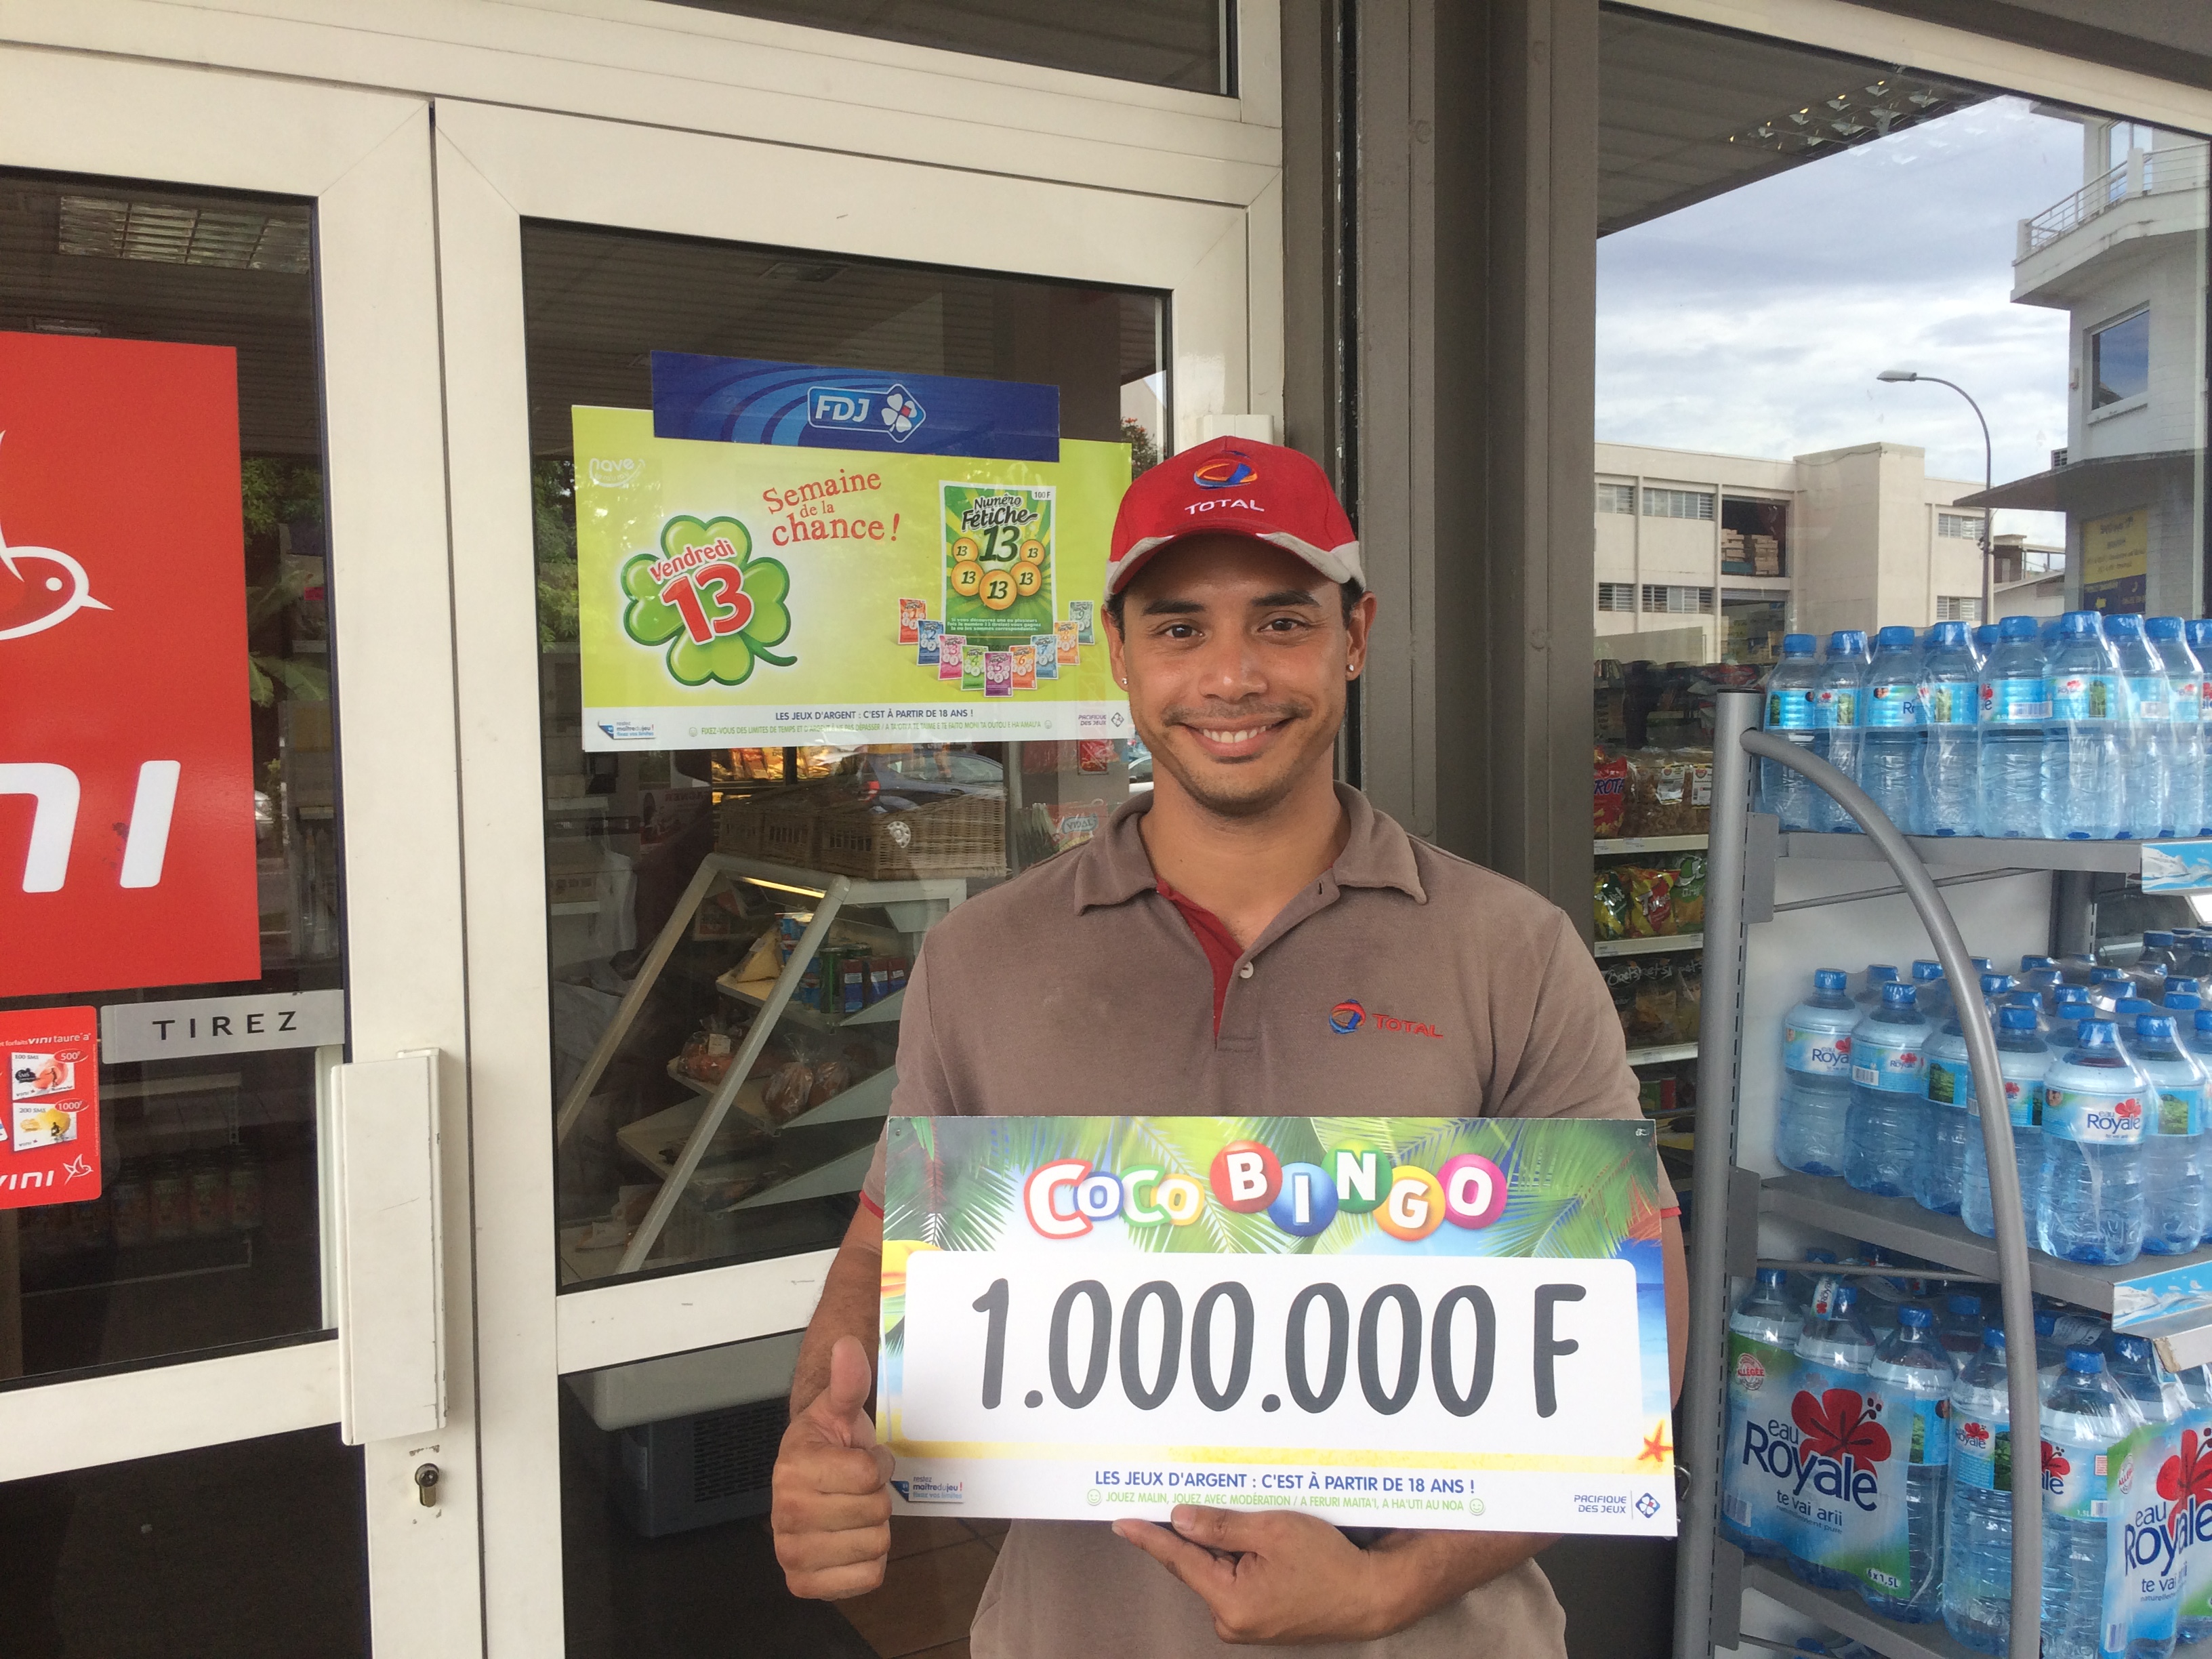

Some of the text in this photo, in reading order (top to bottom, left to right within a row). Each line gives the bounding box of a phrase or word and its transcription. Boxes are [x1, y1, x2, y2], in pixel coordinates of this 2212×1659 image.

[815, 395, 870, 422] FDJ
[762, 468, 882, 514] Semaine
[800, 500, 835, 518] de la
[1185, 499, 1265, 515] TOTAL
[772, 512, 885, 547] chance
[956, 546, 968, 556] 13
[979, 525, 1021, 562] 13
[1027, 548, 1038, 558] 13
[649, 539, 735, 582] Vendredi
[961, 571, 977, 584] 13
[1019, 572, 1033, 586] 13
[987, 580, 1009, 600] 13
[661, 563, 752, 643] 13
[775, 712, 790, 720] LES
[792, 712, 813, 720] JEUX
[815, 711, 856, 720] D'ARGENT
[863, 710, 885, 718] C'EST
[887, 708, 894, 718] À
[896, 710, 924, 718] PARTIR
[926, 710, 937, 718] DE
[939, 709, 948, 718] 18
[950, 709, 968, 717] ANS
[748, 726, 769, 734] LIMITES
[777, 725, 796, 733] TEMPS
[152, 1011, 297, 1041] TIREZ
[1371, 1013, 1443, 1039] TOTAL
[2087, 1113, 2141, 1134] Royale
[972, 1277, 1586, 1418] 1.000.000 F
[1768, 1418, 1799, 1446] eau
[1742, 1420, 1878, 1511] Royale
[1095, 1471, 1120, 1485] LES
[1124, 1471, 1164, 1486] JEUX
[1168, 1472, 1247, 1488] D'ARGENT
[1262, 1473, 1304, 1489] C'EST
[1309, 1471, 1320, 1490] À
[1325, 1476, 1378, 1491] PARTIR
[1383, 1477, 1404, 1491] DE
[1408, 1478, 1425, 1492] 18
[1431, 1479, 1465, 1493] ANS
[1105, 1492, 1135, 1502] JOUEZ
[1138, 1492, 1169, 1504] MALIN,
[1172, 1493, 1202, 1504] JOUEZ
[1204, 1494, 1227, 1504] AVEC
[1230, 1492, 1291, 1506] MODÉRATION
[1300, 1496, 1307, 1506] A
[1310, 1496, 1340, 1507] FERURI
[1382, 1498, 1389, 1509] A
[1391, 1498, 1423, 1509] HA'UTI
[1426, 1499, 1439, 1510] AU
[1443, 1499, 1464, 1511] NOA
[1574, 1495, 1627, 1505] PACIFIQUE
[1578, 1504, 1626, 1514] DES JEUX
[1776, 1489, 1842, 1526] te vai arii
[2135, 1501, 2167, 1528] eau
[2125, 1497, 2212, 1577] Royale
[2142, 1578, 2155, 1593] te
